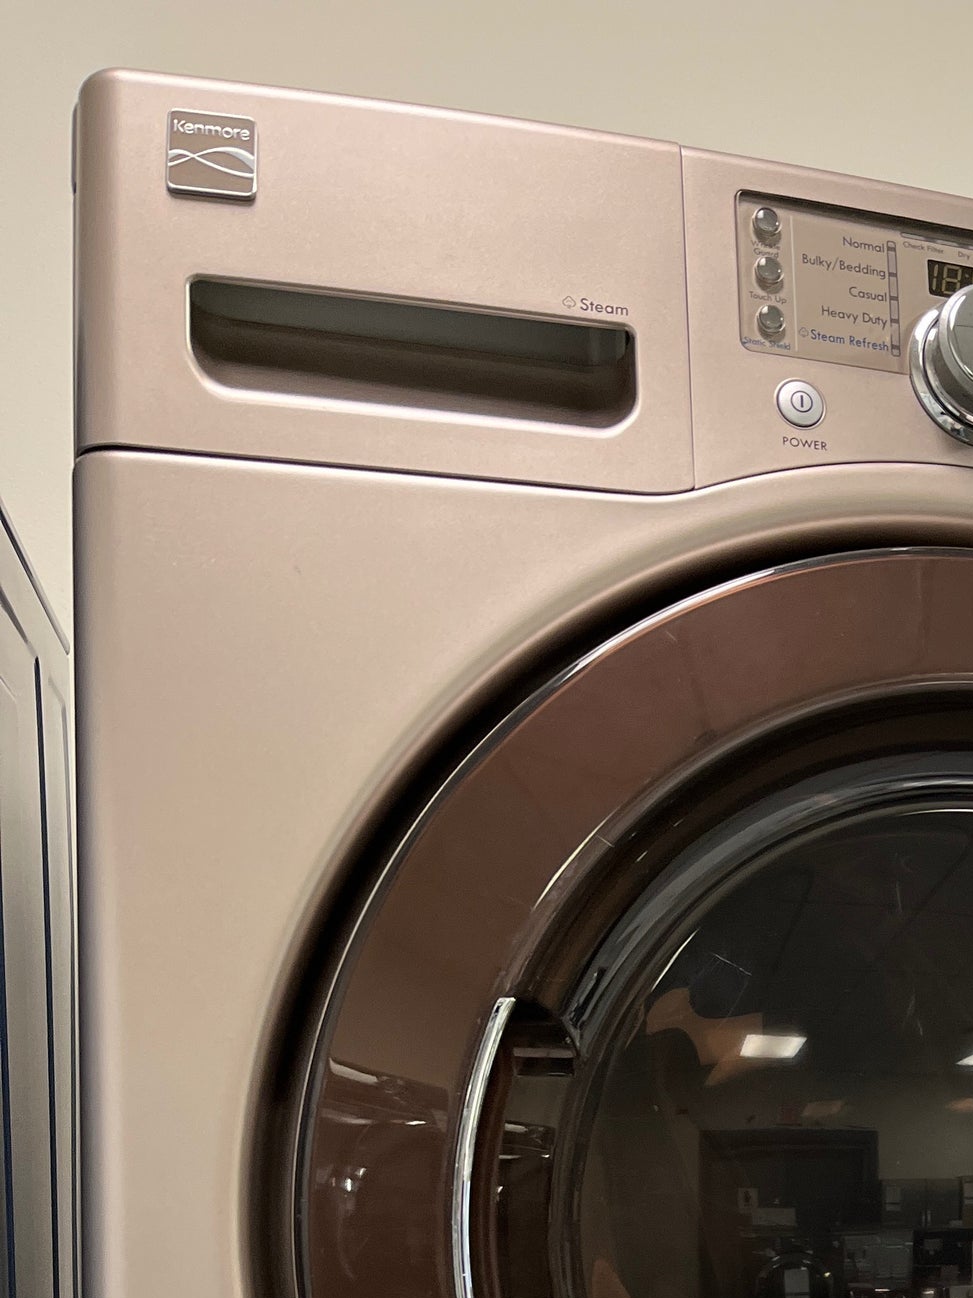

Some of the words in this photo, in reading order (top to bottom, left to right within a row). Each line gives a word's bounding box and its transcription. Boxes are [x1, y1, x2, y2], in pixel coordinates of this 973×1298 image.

[173, 119, 250, 141] Kenmore
[842, 236, 885, 253] Normal
[957, 250, 970, 260] Dry
[802, 253, 886, 280] Bulky/Bedding
[749, 290, 772, 301] Touch
[774, 295, 787, 304] Up
[848, 286, 887, 302] Casual
[580, 297, 629, 316] Steam
[821, 305, 858, 324] Heavy
[862, 312, 888, 331] Duty
[810, 328, 845, 344] Steam
[849, 335, 889, 352] Refresh
[782, 436, 828, 451] POWER
